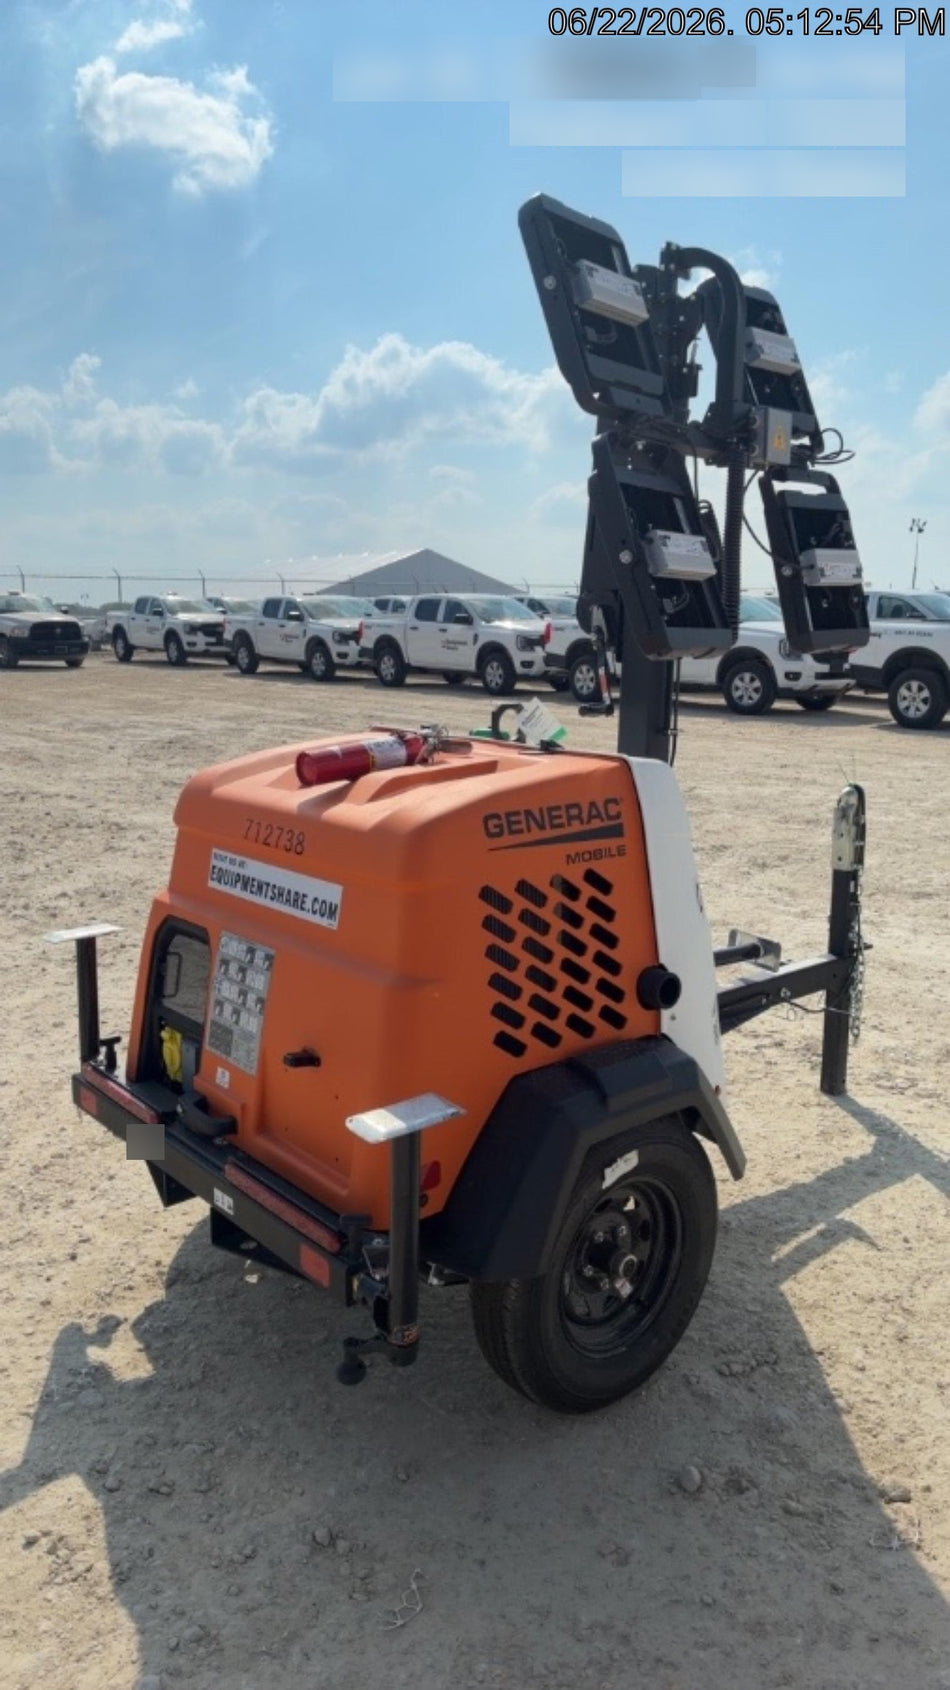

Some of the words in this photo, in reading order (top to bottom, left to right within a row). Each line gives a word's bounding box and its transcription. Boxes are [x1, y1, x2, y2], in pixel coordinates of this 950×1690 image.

[243, 817, 305, 856] 712738
[482, 797, 622, 839] GENERAC
[565, 844, 627, 866] MOBILE
[209, 865, 339, 922] EQUIPMENTSHARE.COM
